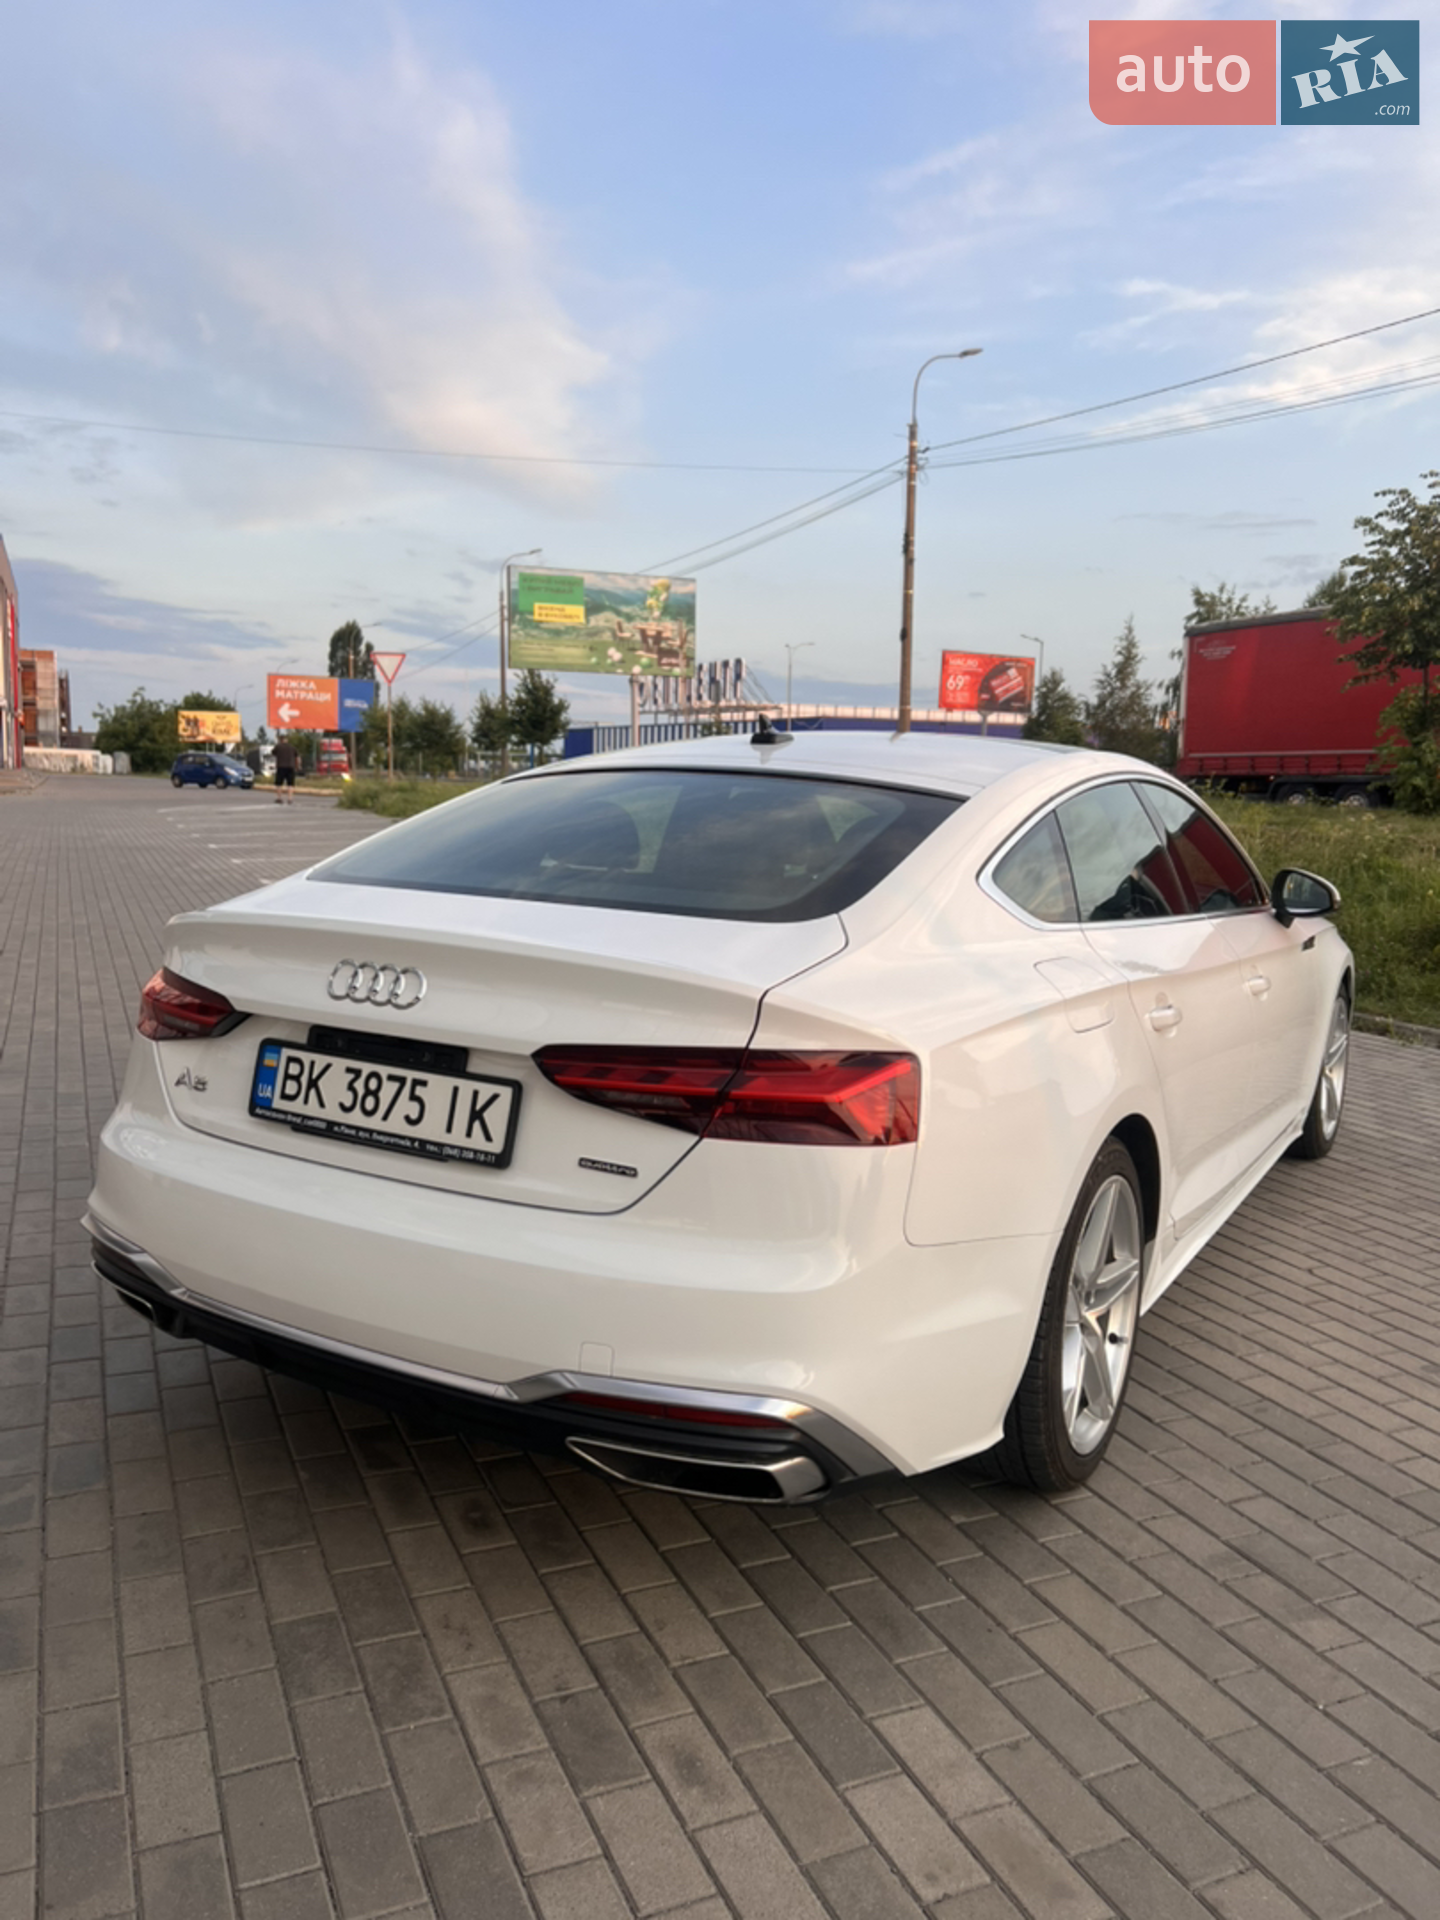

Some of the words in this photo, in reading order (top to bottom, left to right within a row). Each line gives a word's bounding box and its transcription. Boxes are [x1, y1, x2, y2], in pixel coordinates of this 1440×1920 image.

[275, 678, 317, 691] ЛІЖКА
[946, 674, 964, 691] 69
[274, 689, 332, 703] МАТРАЦИ
[256, 1082, 273, 1099] UA
[279, 1055, 333, 1109] BK
[338, 1066, 429, 1128] 3875
[445, 1085, 502, 1143] IK
[579, 1158, 638, 1178] quattro
